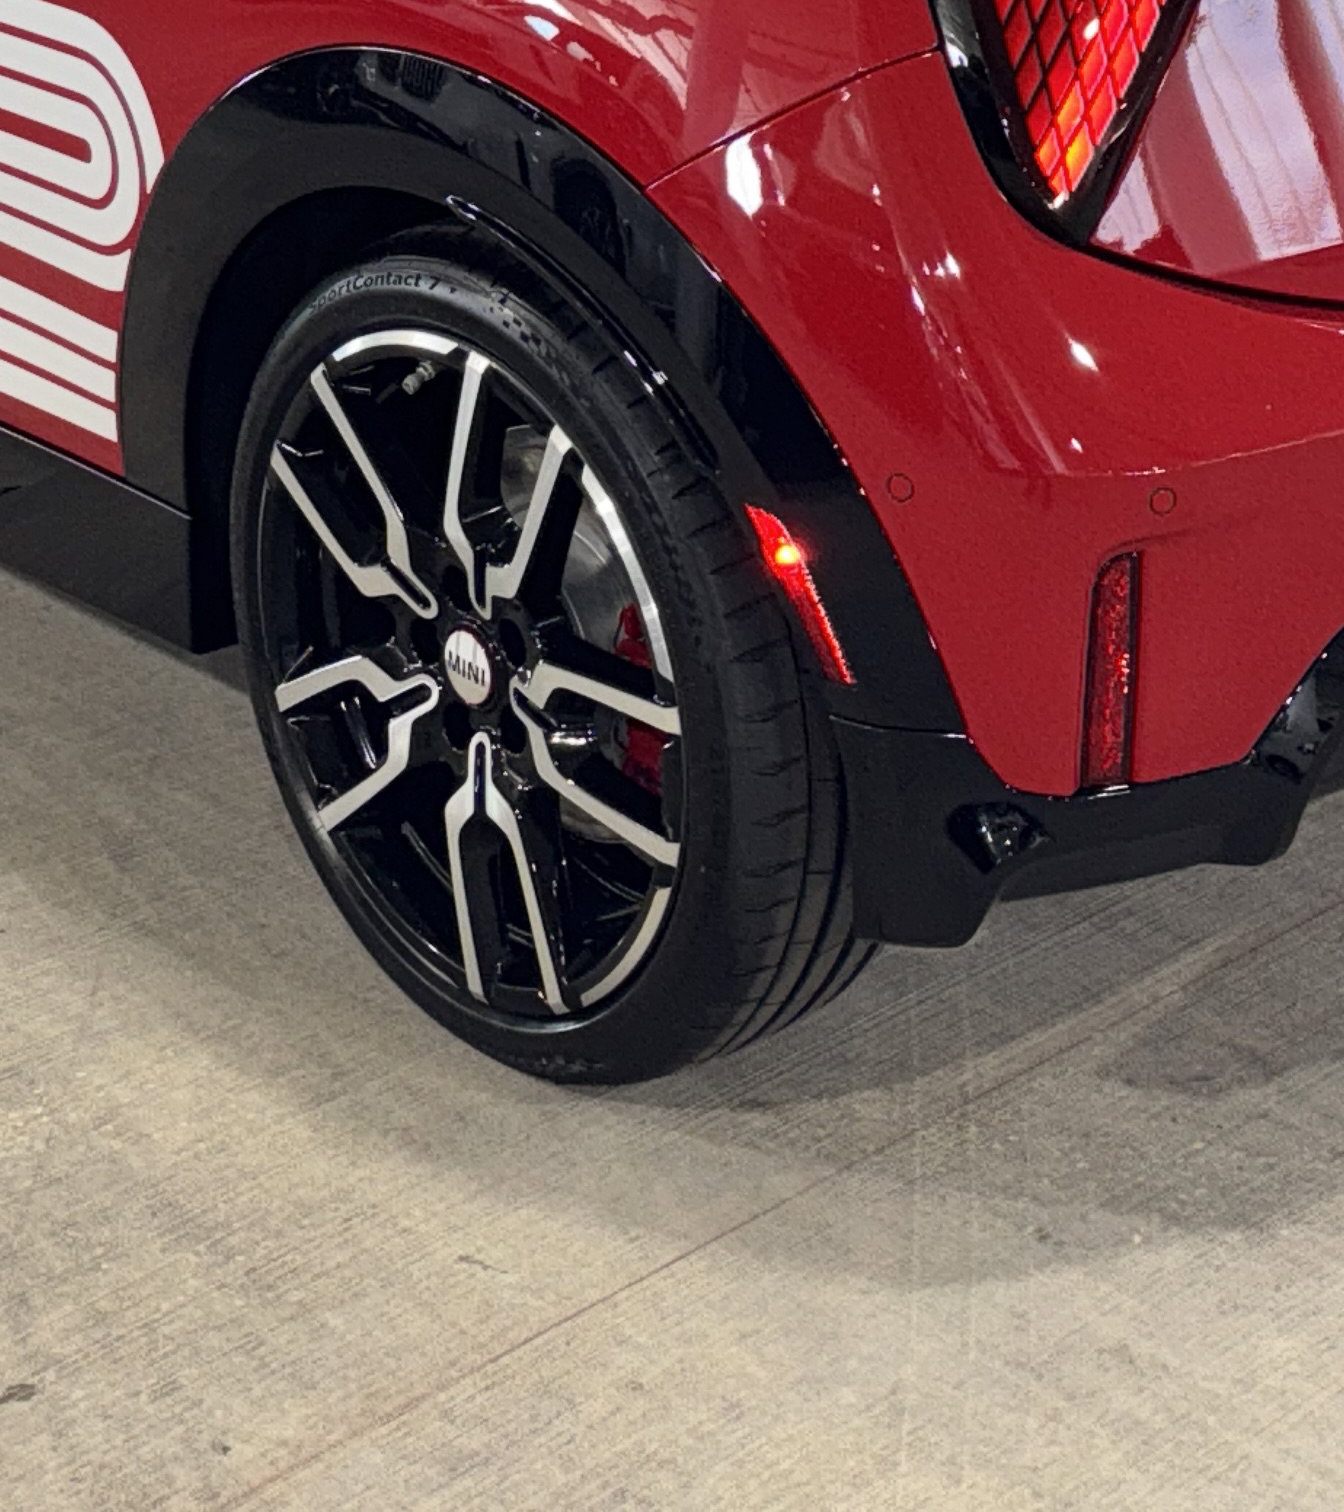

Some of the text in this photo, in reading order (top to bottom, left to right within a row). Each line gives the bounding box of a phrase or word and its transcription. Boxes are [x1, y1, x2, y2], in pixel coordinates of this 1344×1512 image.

[308, 271, 442, 316] SportContact 7
[448, 650, 485, 686] MINI
